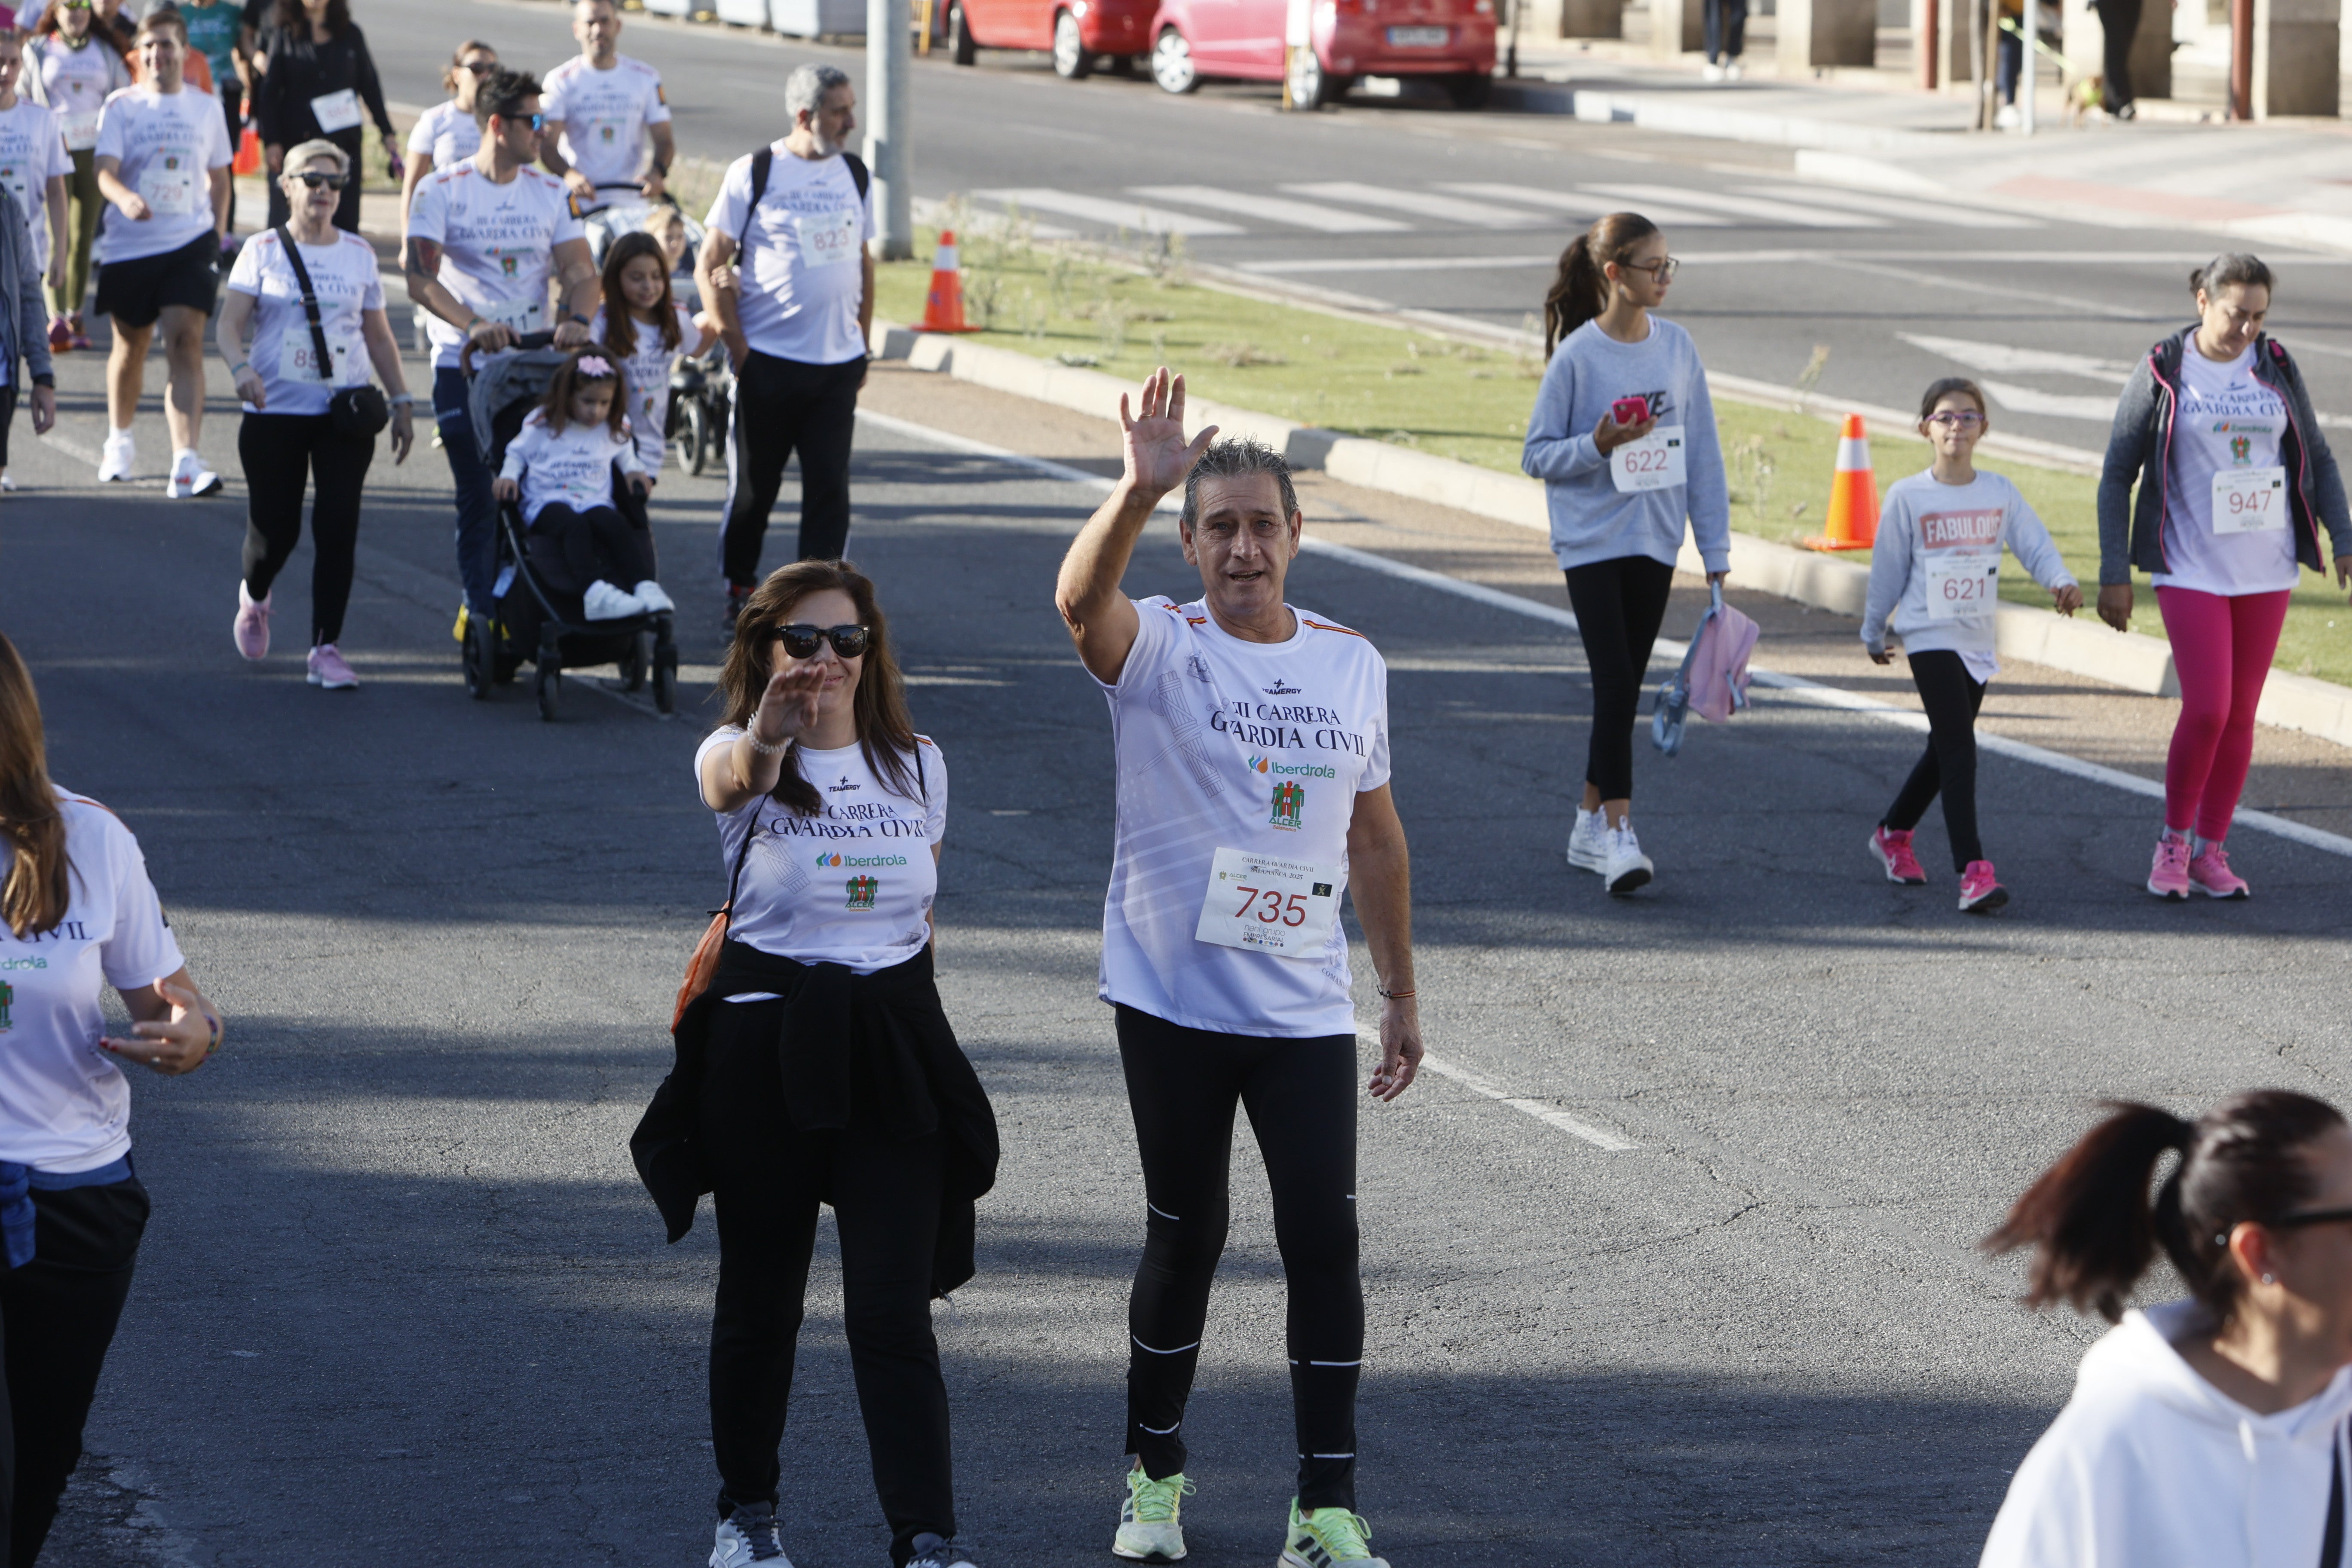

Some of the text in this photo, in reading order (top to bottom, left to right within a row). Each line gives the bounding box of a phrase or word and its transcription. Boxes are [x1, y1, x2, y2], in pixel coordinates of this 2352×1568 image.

[813, 228, 849, 251] 823
[496, 314, 527, 331] 11
[1626, 449, 1668, 473] 622
[2229, 489, 2272, 514] 947
[1944, 578, 1984, 600] 621
[1256, 704, 1342, 725] CARRERA
[1315, 729, 1366, 757] CIVIL
[1272, 762, 1335, 779] Iberdrola
[828, 784, 861, 793] TEAMERGY
[828, 803, 900, 821] CARRERA
[771, 818, 874, 840] GVARDIA
[1268, 817, 1302, 830] ALCER
[844, 854, 907, 867] Iberdrola
[1242, 857, 1270, 866] CARRERA
[1234, 886, 1308, 927] 735
[1243, 931, 1284, 943] EMPRESARIAL
[1244, 925, 1286, 937] nani grupo
[0, 955, 48, 970] drola
